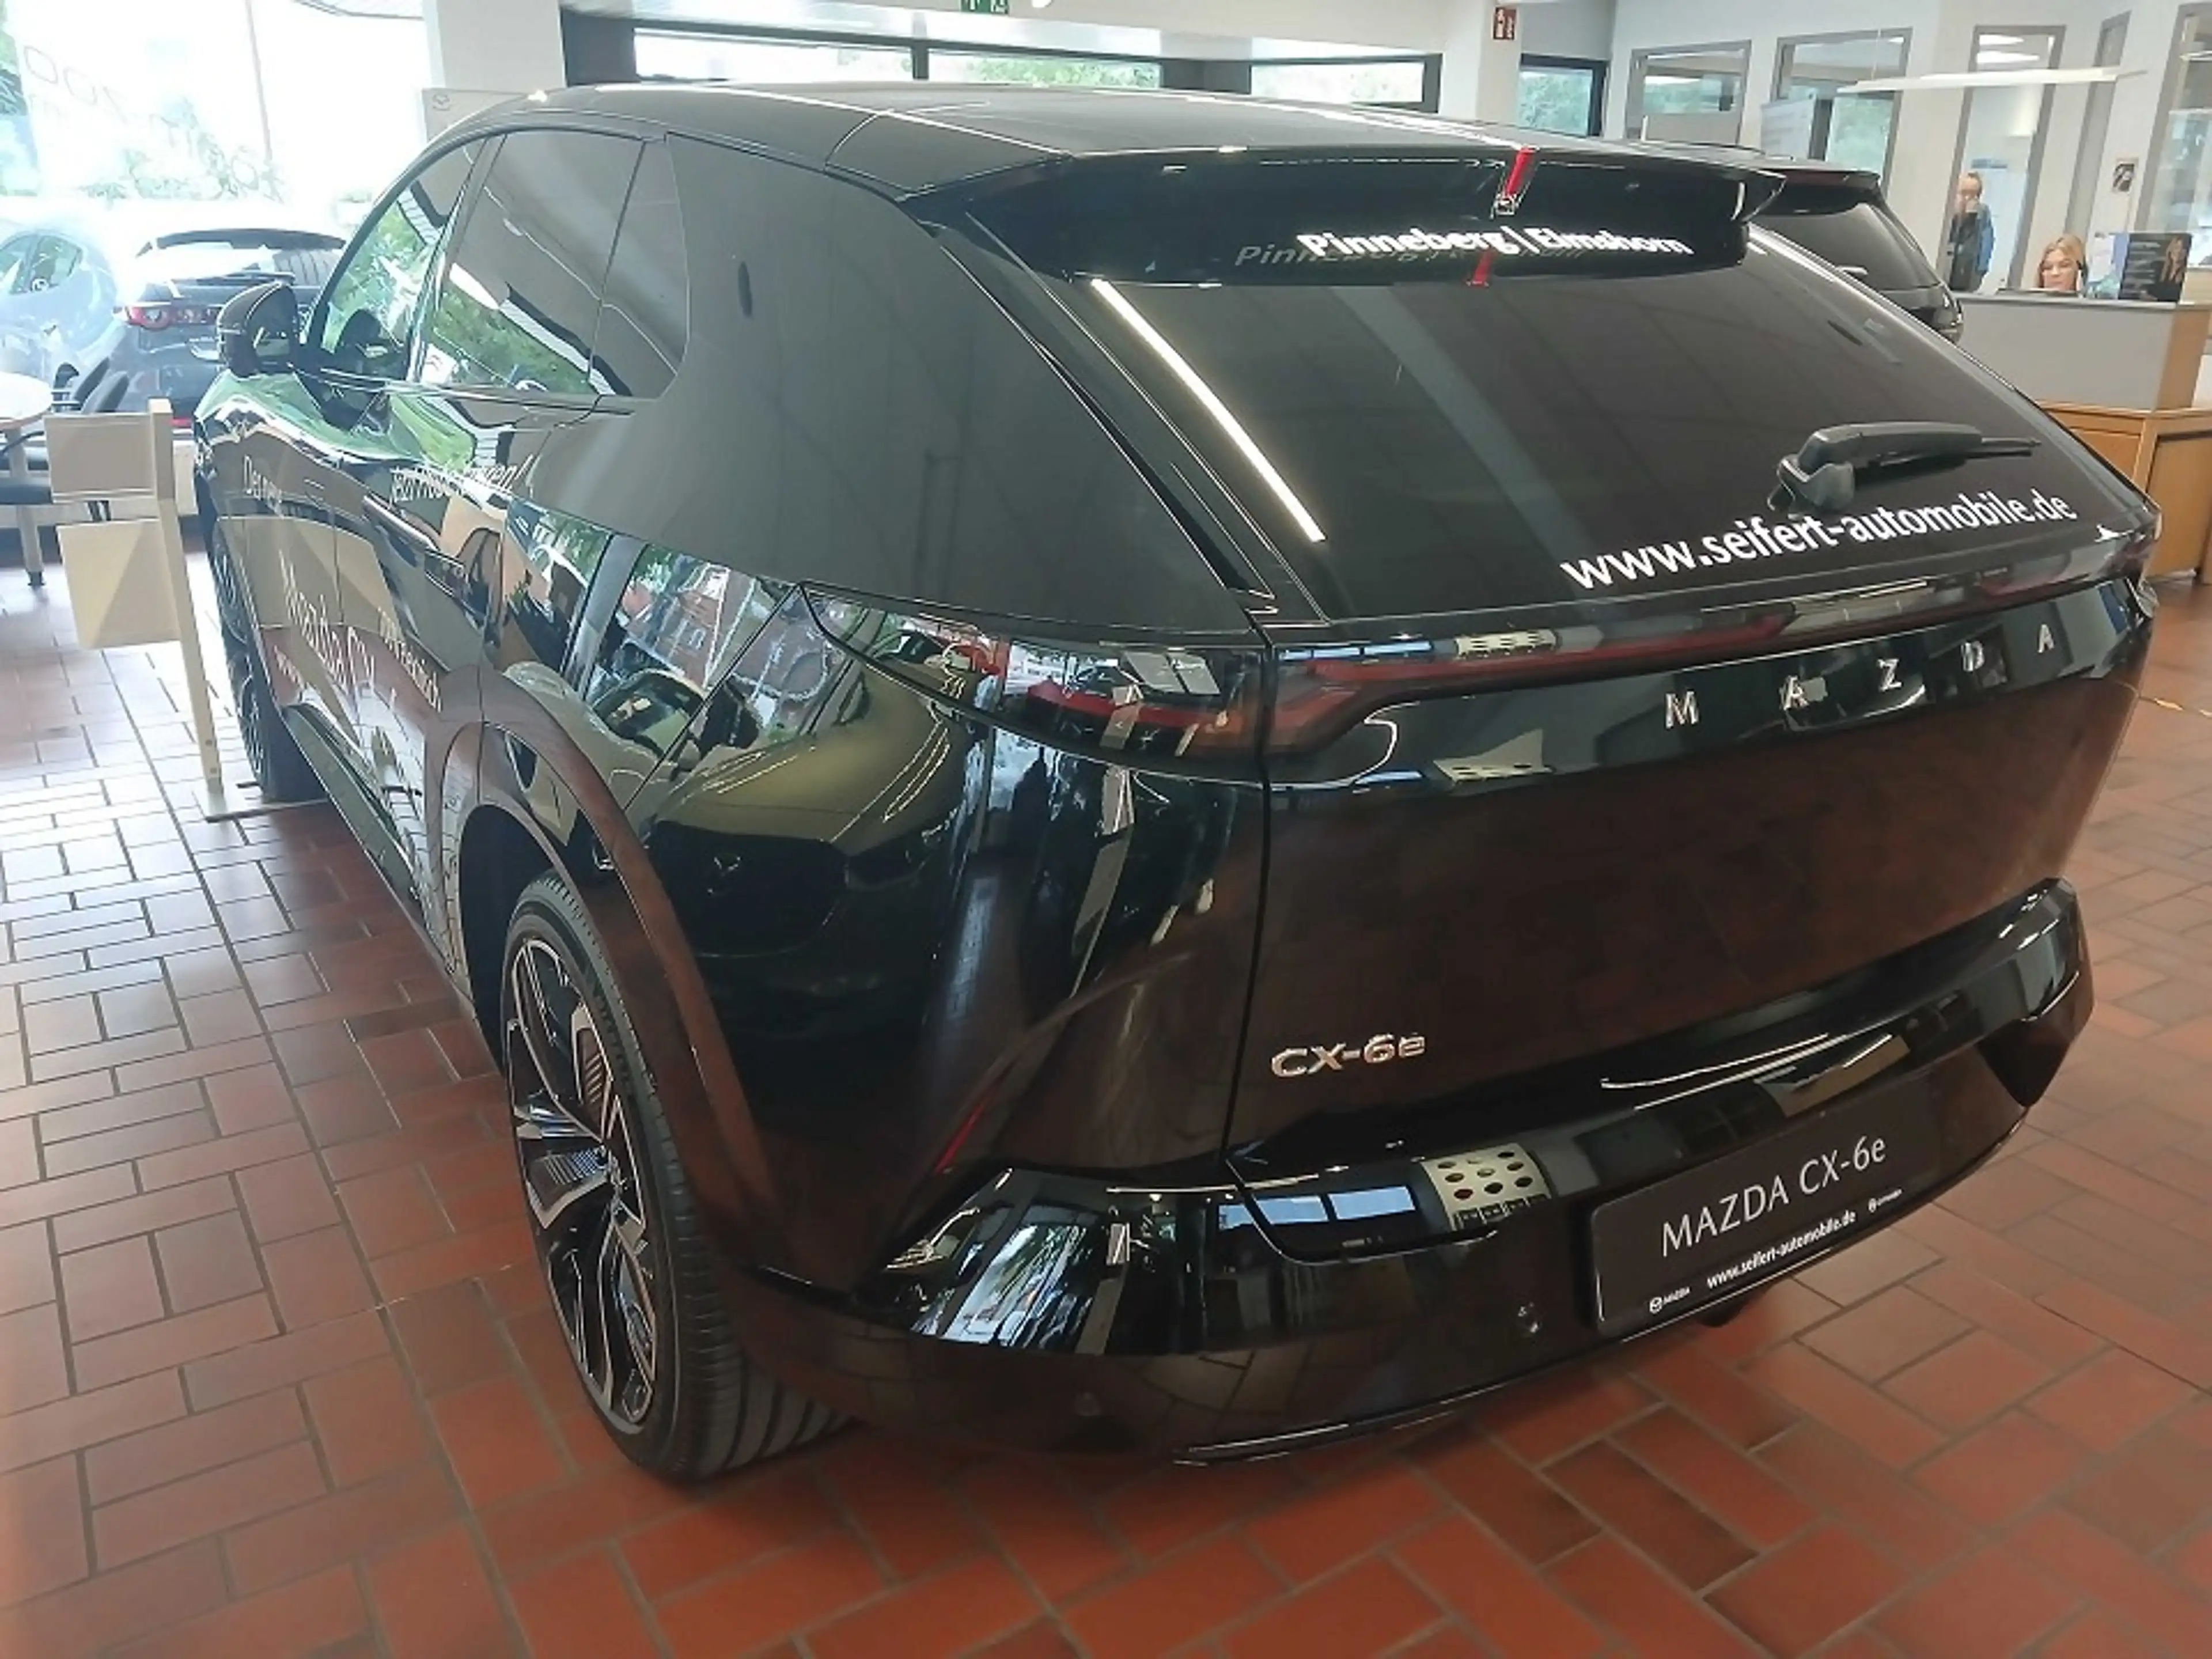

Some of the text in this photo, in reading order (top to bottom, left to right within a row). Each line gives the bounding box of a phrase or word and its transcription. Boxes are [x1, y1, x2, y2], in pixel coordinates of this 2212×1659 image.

[1296, 228, 1520, 257] Pinneberg
[1523, 228, 1695, 255] Elmshorn
[1559, 488, 2077, 590] www.seifert-automobile.de
[1665, 623, 2055, 729] MAZDA
[1271, 1032, 1426, 1078] CX-6e
[1661, 1135, 1887, 1257] MAZDA CX-6e
[1706, 1210, 1856, 1289] www.seifert-automobile.de
